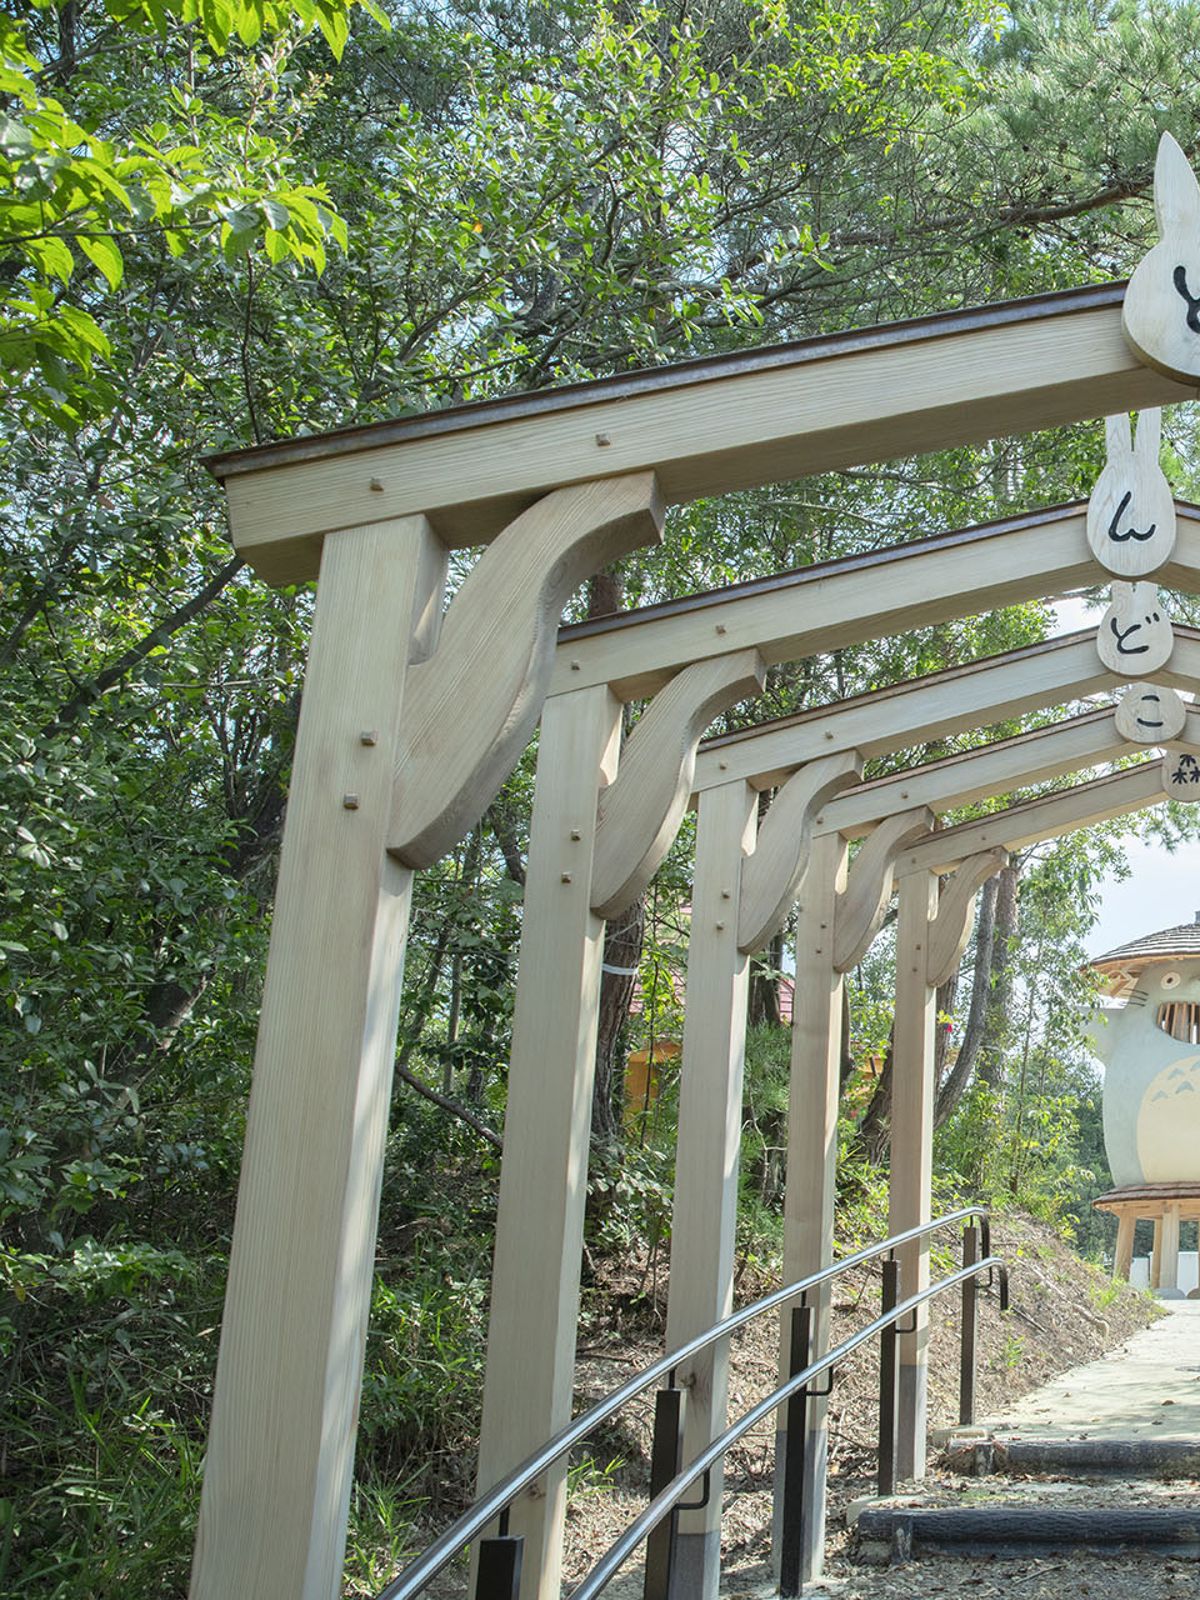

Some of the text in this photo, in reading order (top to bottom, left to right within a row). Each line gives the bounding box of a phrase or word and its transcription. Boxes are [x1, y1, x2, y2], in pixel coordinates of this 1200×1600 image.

[1108, 491, 1156, 542] ん
[1110, 612, 1160, 655] ど
[1136, 694, 1164, 728] こ
